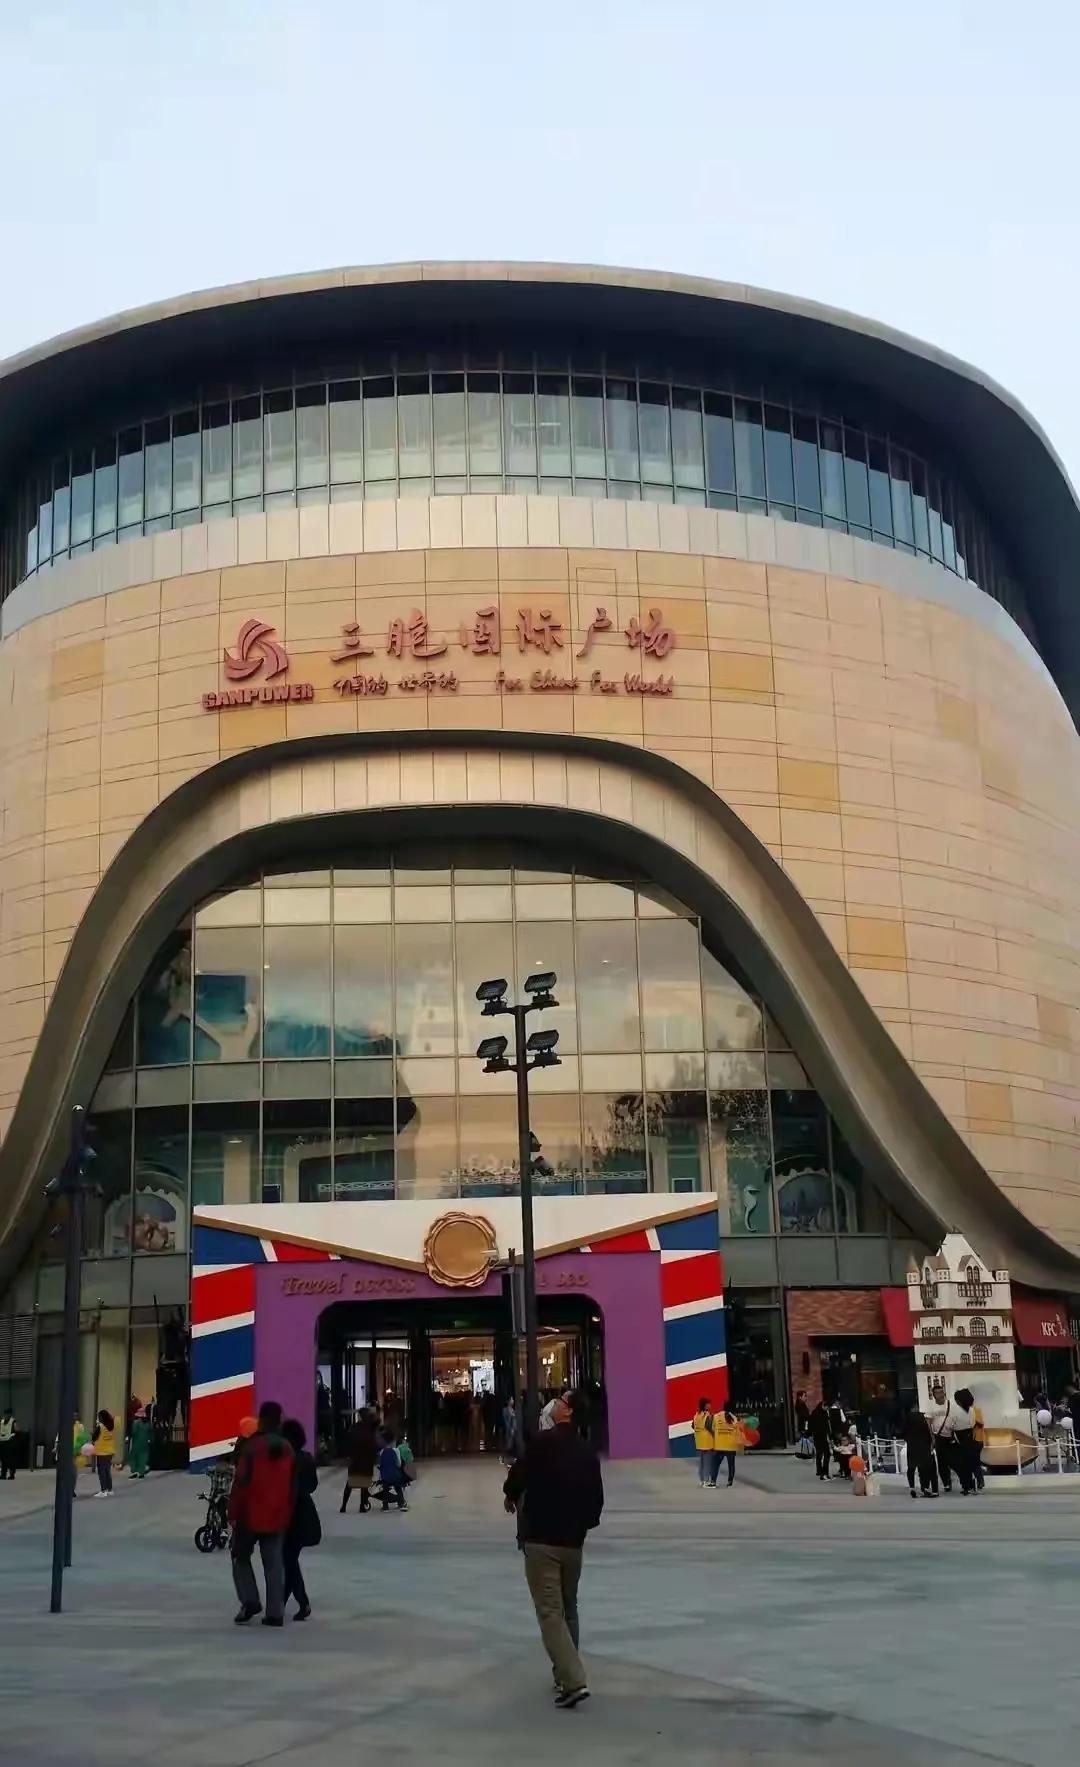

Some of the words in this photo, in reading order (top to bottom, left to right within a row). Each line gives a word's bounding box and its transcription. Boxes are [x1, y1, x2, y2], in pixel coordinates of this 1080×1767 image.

[330, 607, 675, 662] 三胞国际广场
[202, 683, 314, 711] SANPOWER
[1041, 1321, 1057, 1337] KFC
